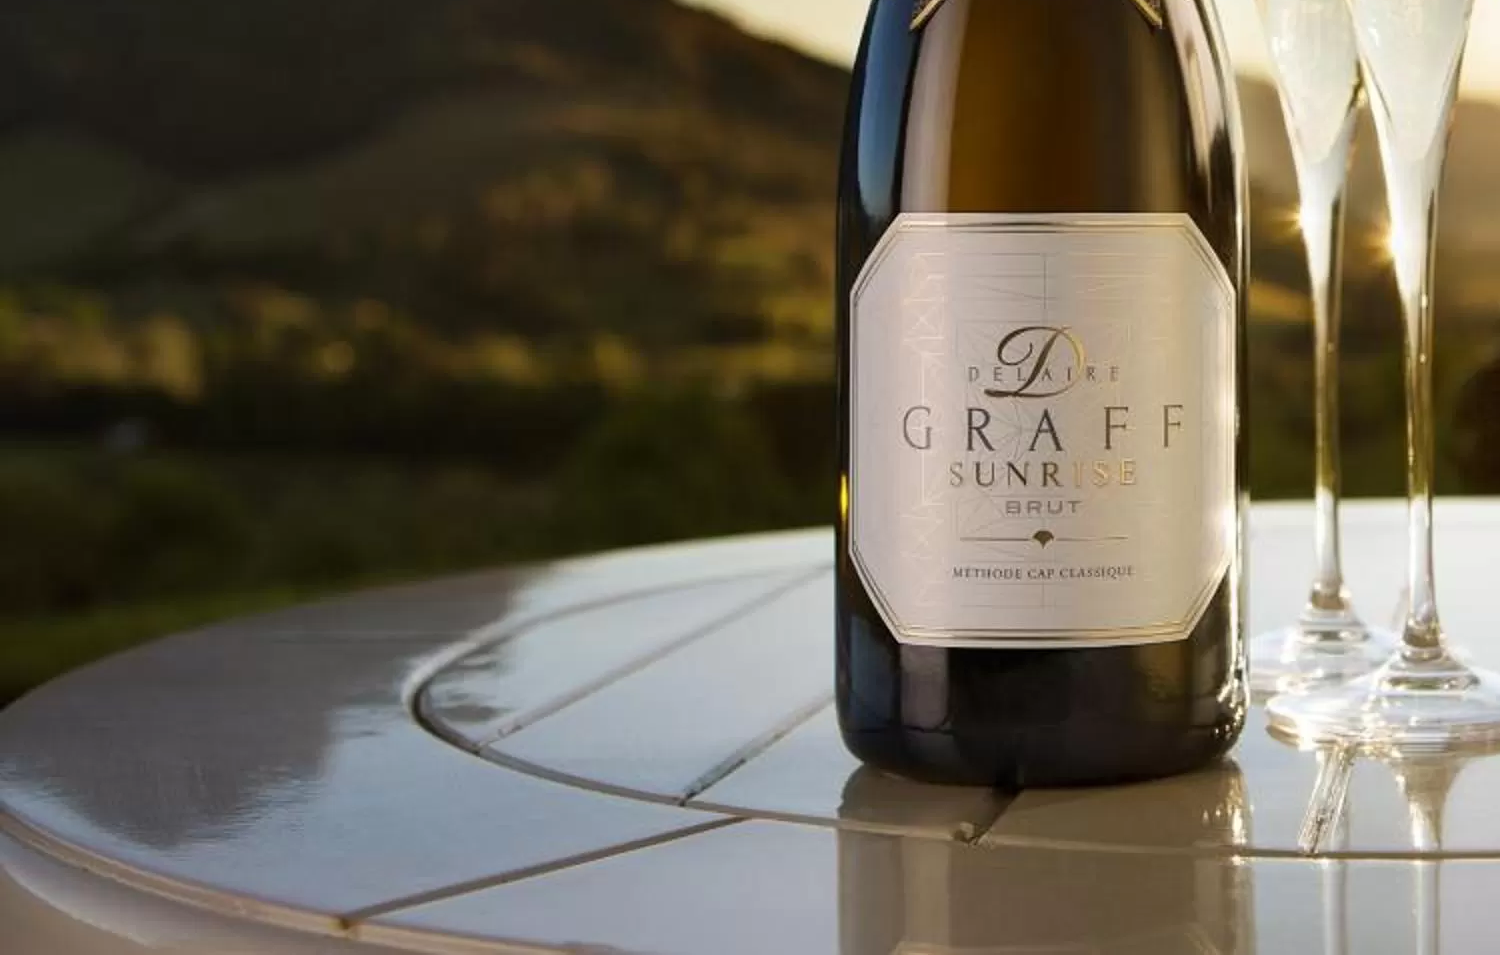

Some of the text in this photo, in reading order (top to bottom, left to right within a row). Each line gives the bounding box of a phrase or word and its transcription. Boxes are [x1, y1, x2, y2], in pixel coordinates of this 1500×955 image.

[967, 365, 1121, 383] DELAIRE
[903, 404, 1184, 452] GRAFF
[949, 460, 1138, 488] SUNRISE
[1005, 500, 1083, 515] BRUT
[1027, 567, 1055, 580] CAP
[1059, 564, 1136, 580] CLASSIQUE
